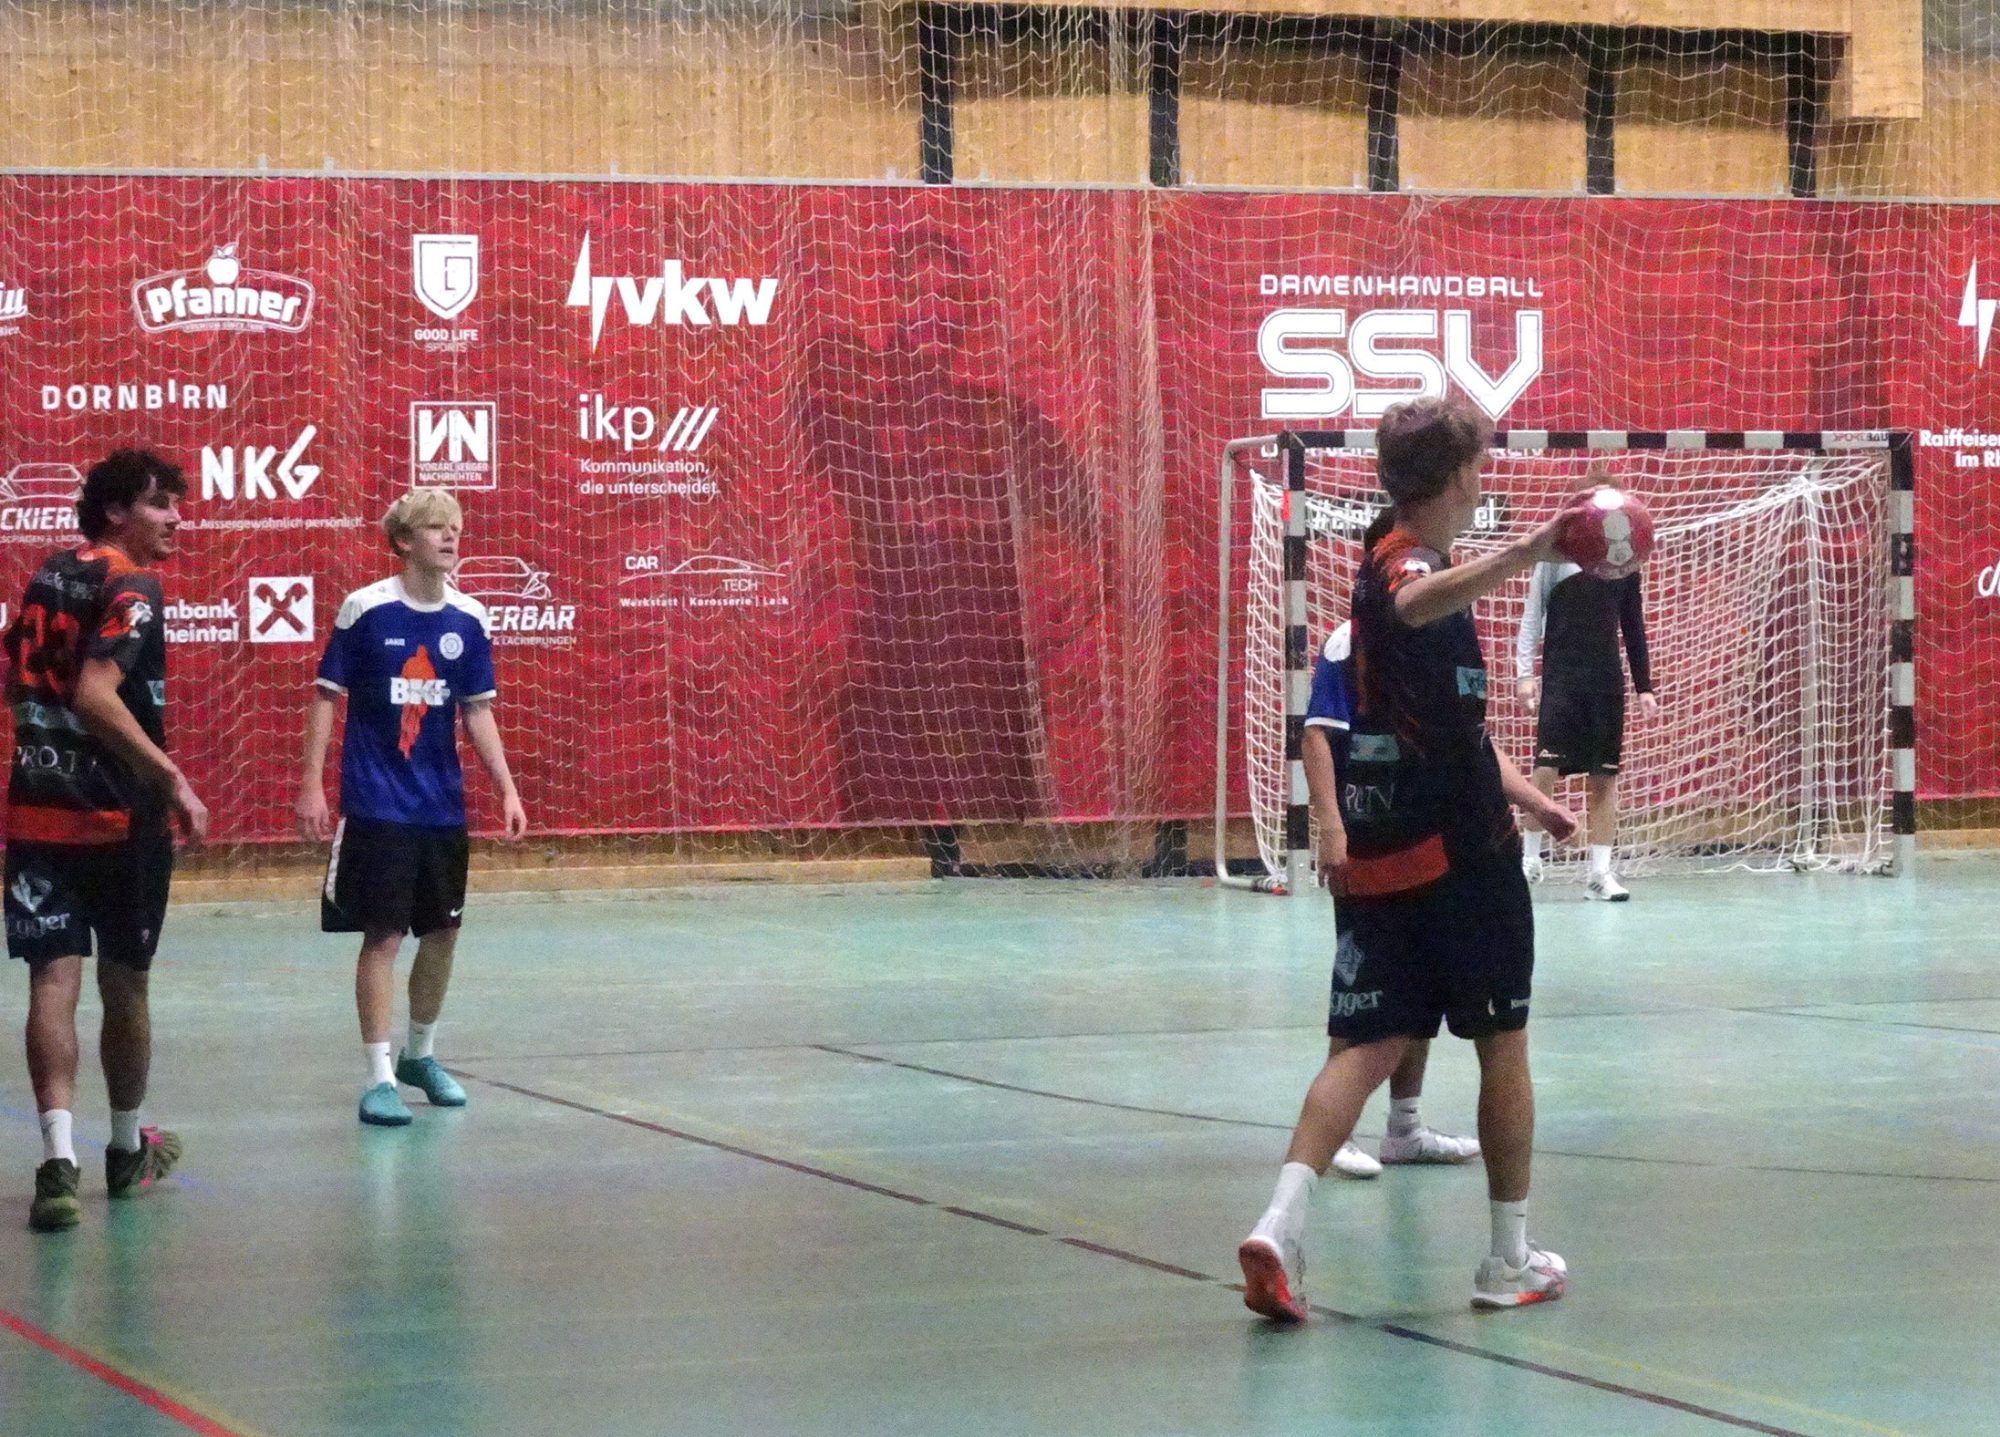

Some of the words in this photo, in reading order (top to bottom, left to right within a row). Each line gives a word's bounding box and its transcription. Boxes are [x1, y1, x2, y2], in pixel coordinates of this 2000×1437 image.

[616, 259, 779, 325] vkw
[1260, 274, 1543, 297] DAMENHANDBALL
[414, 329, 449, 340] GOOD
[451, 329, 479, 341] LIFE
[425, 342, 468, 353] SPORTS
[1257, 308, 1543, 421] SSV
[42, 379, 228, 410] DORNBIRN
[579, 394, 656, 451] ikp
[1919, 428, 2000, 447] Raiffeise
[201, 425, 321, 500] NKG
[580, 459, 710, 474] Kommunikation,
[580, 479, 605, 494] die
[625, 556, 659, 570] CAR
[722, 579, 758, 591] TECH
[620, 597, 679, 607] Werkstatt
[763, 597, 789, 606] Lack
[488, 605, 576, 631] ERBAR
